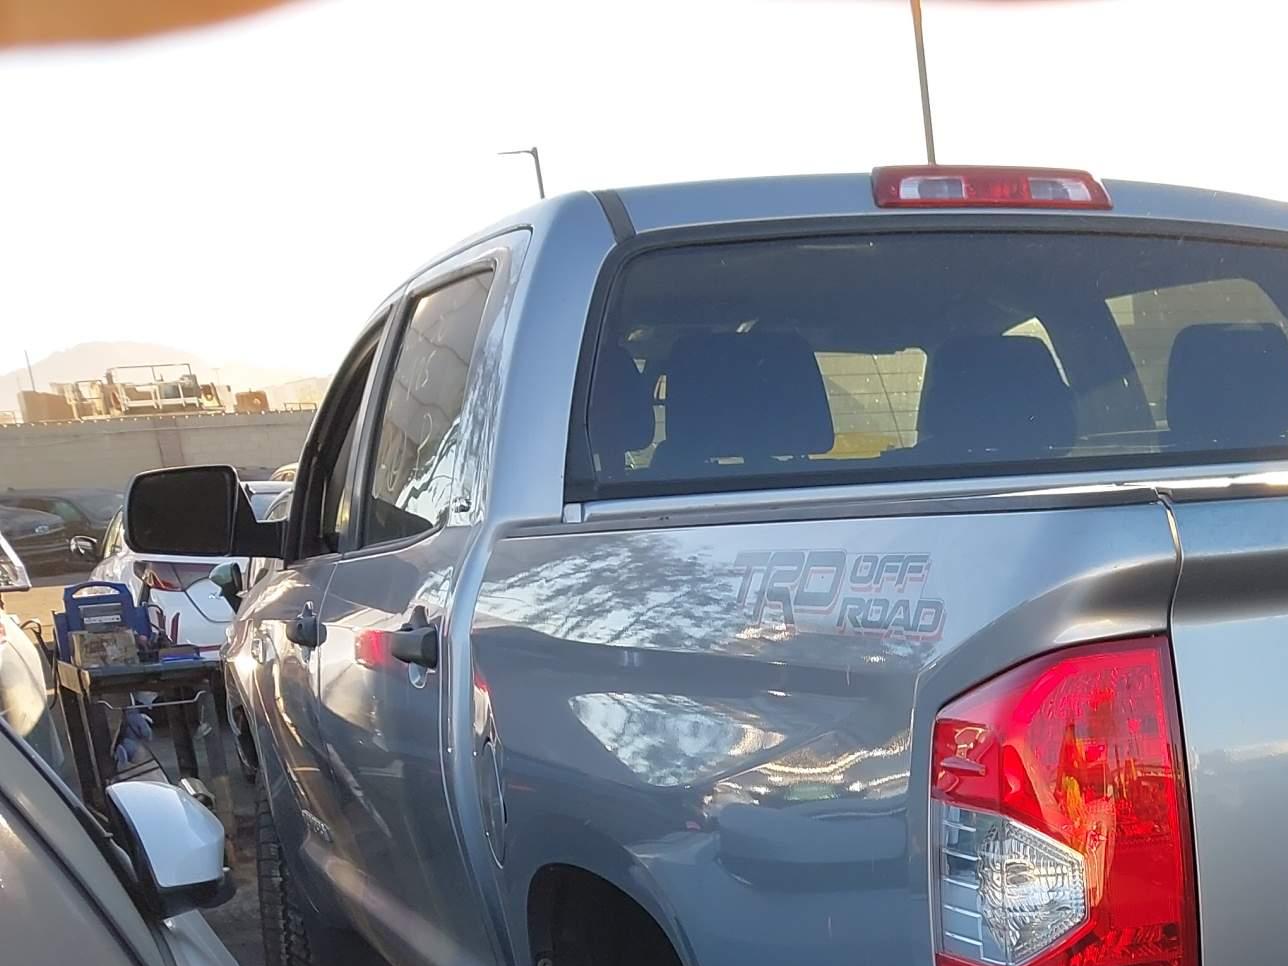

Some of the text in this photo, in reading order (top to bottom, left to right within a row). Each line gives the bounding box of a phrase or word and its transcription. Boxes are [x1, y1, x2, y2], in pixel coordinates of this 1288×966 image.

[735, 548, 847, 631] TRD
[849, 552, 932, 589] OFF
[836, 596, 947, 639] ROAD
